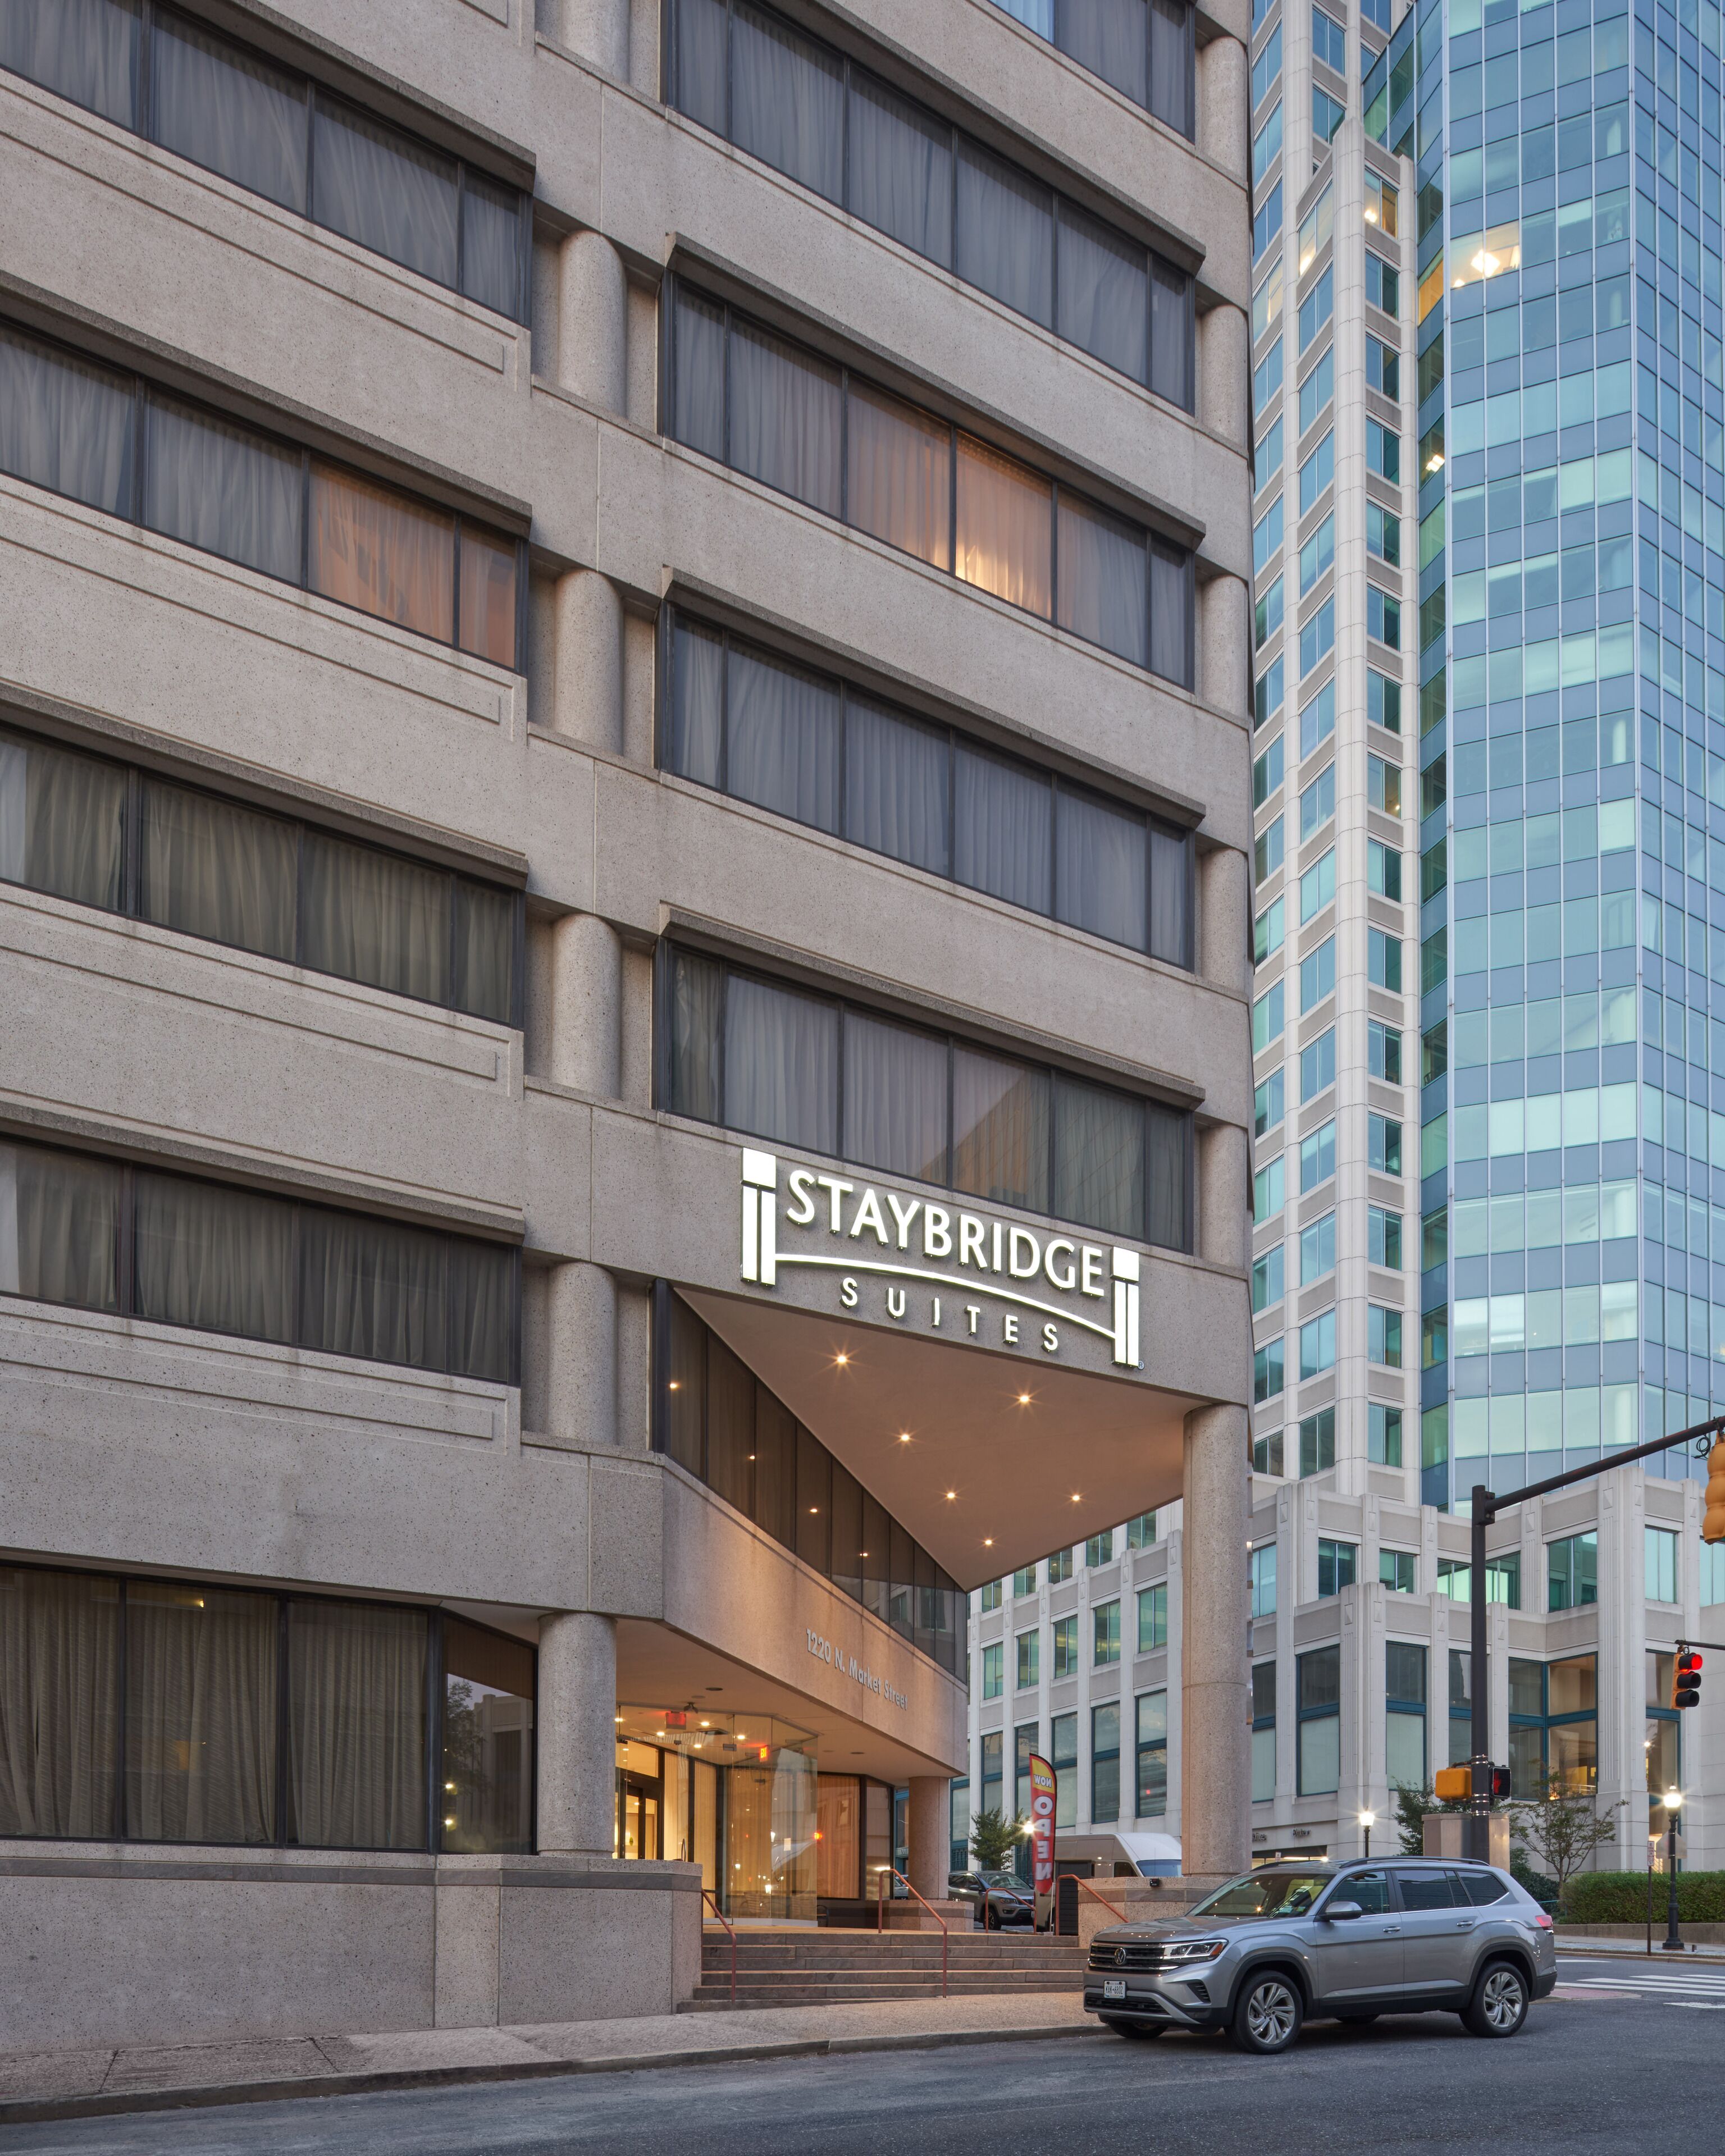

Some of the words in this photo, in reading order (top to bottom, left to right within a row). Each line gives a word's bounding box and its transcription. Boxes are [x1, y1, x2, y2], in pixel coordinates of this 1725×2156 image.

[787, 1170, 1105, 1298] STAYBRIDGE
[839, 1277, 1058, 1353] SUITES
[806, 1628, 831, 1664] 1220
[835, 1646, 845, 1673] N.
[848, 1656, 881, 1695] Market
[884, 1679, 908, 1711] Street
